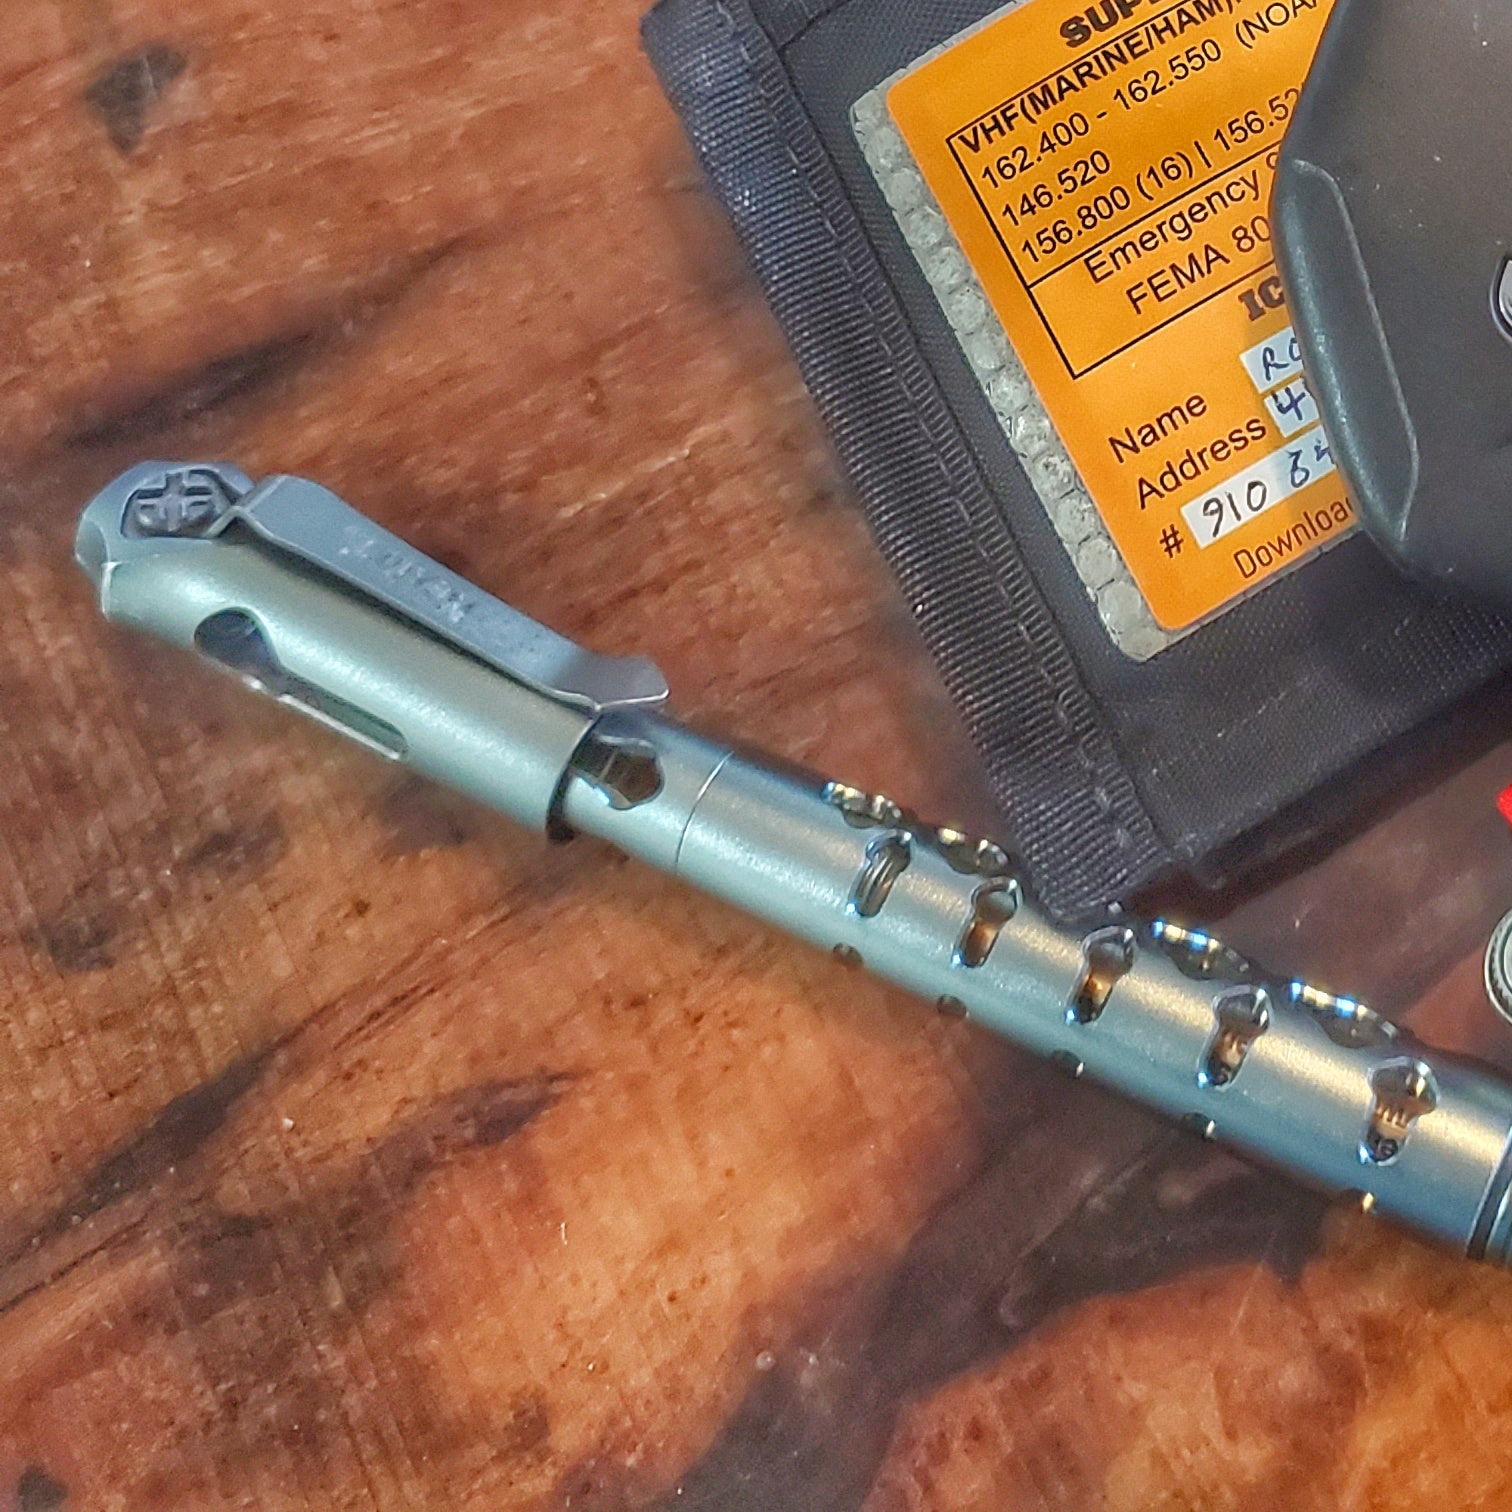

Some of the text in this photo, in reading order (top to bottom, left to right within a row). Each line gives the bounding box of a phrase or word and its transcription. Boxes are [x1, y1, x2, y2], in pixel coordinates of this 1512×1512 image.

[981, 112, 1090, 189] 162.400
[1113, 39, 1222, 111] 162.550
[1002, 150, 1111, 227] 146.520
[1022, 186, 1131, 263] 156.800
[1136, 151, 1194, 200] (16)
[1084, 171, 1260, 283] Emergency
[1126, 244, 1230, 314] FEMA
[1109, 395, 1207, 463] Name
[1137, 417, 1266, 509] Address
[1159, 525, 1183, 559] #
[1203, 480, 1267, 537] 910
[1234, 497, 1353, 578] Downloa
